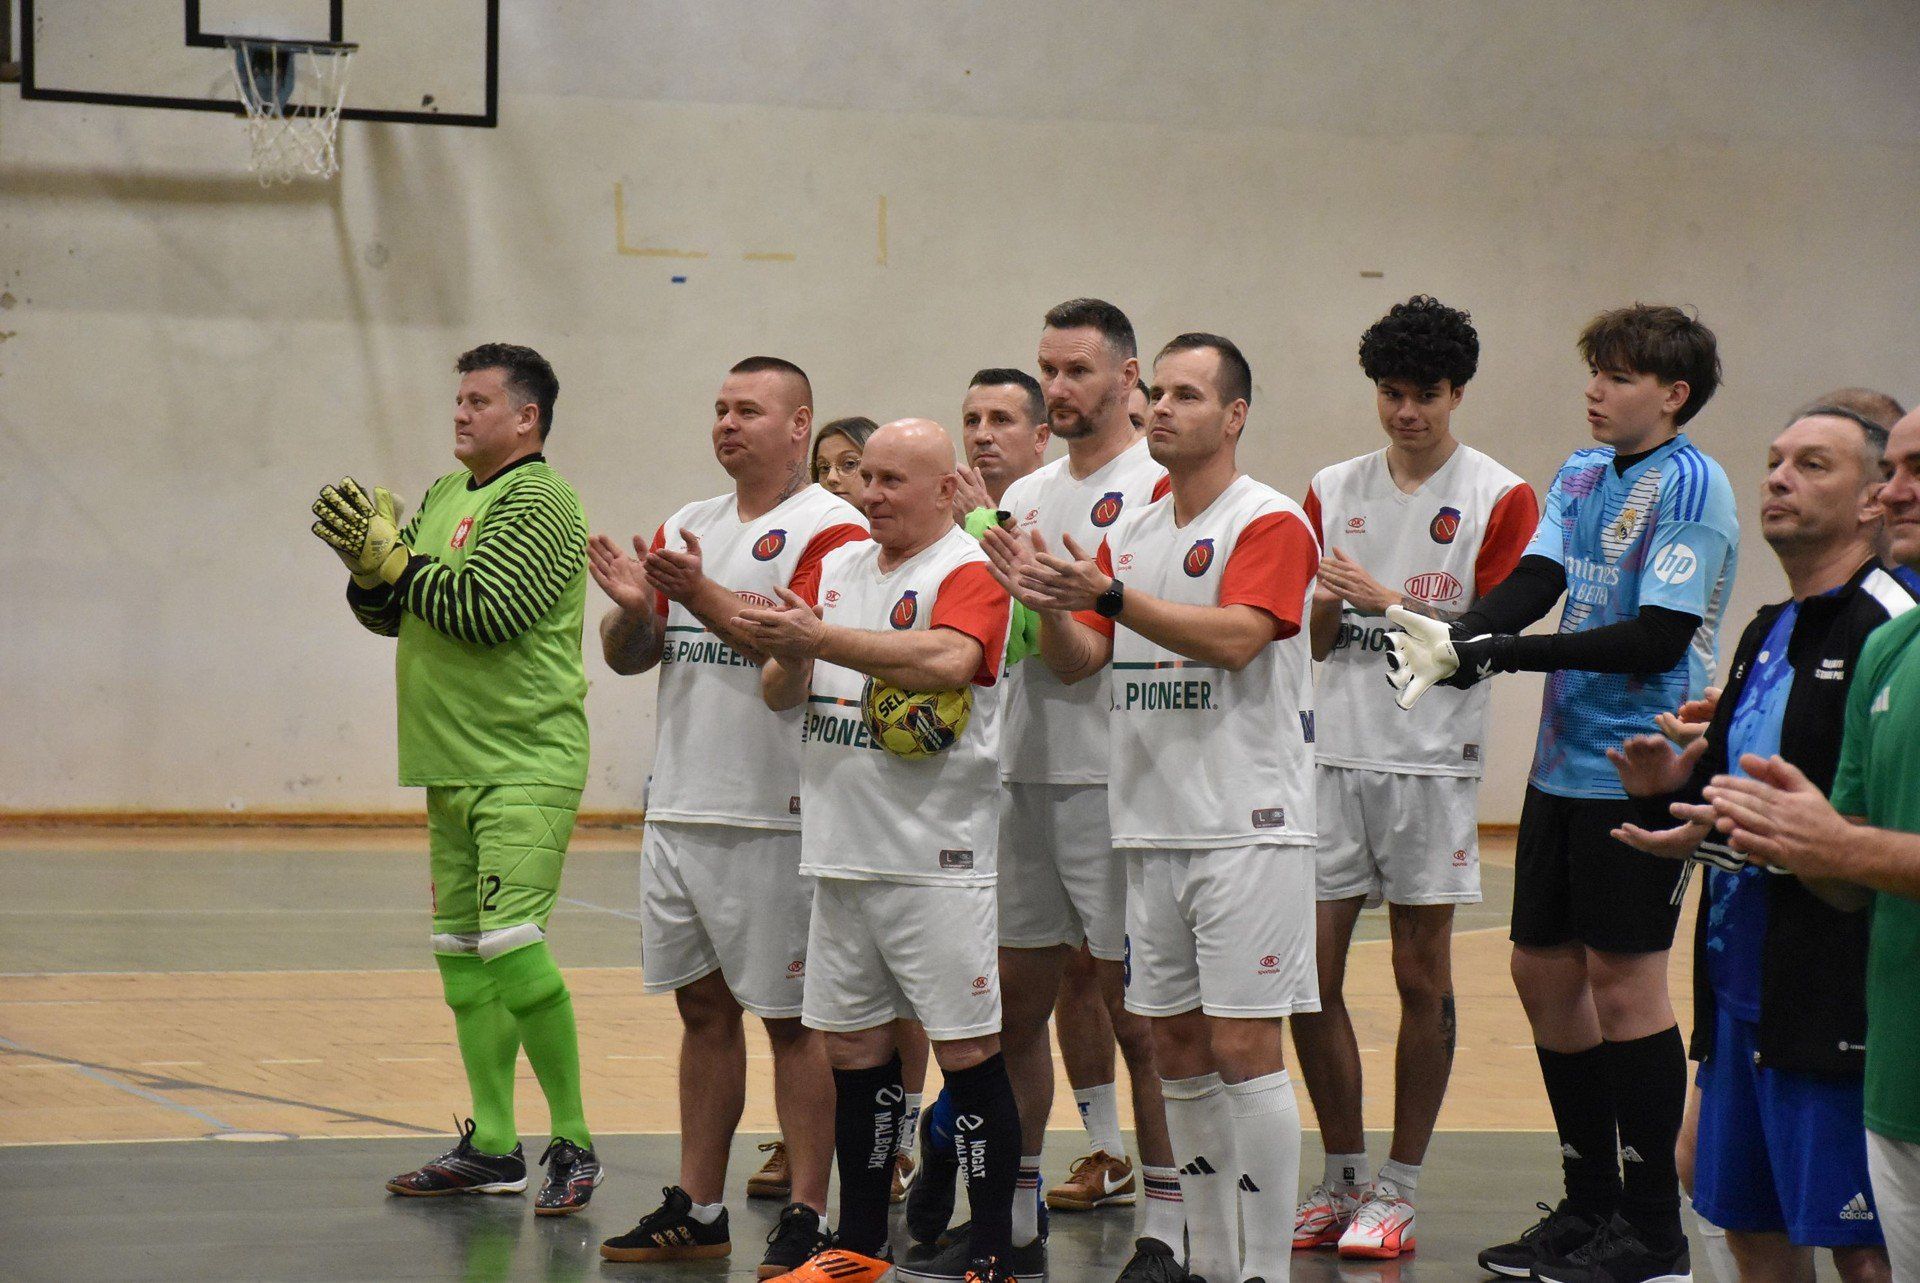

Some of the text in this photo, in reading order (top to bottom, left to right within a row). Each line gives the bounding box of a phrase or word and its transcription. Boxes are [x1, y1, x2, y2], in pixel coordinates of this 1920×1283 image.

[1658, 542, 1695, 585] hp
[868, 1111, 893, 1169] MALBORK
[970, 1139, 987, 1179] NOGAT
[1840, 1210, 1874, 1220] adidas
